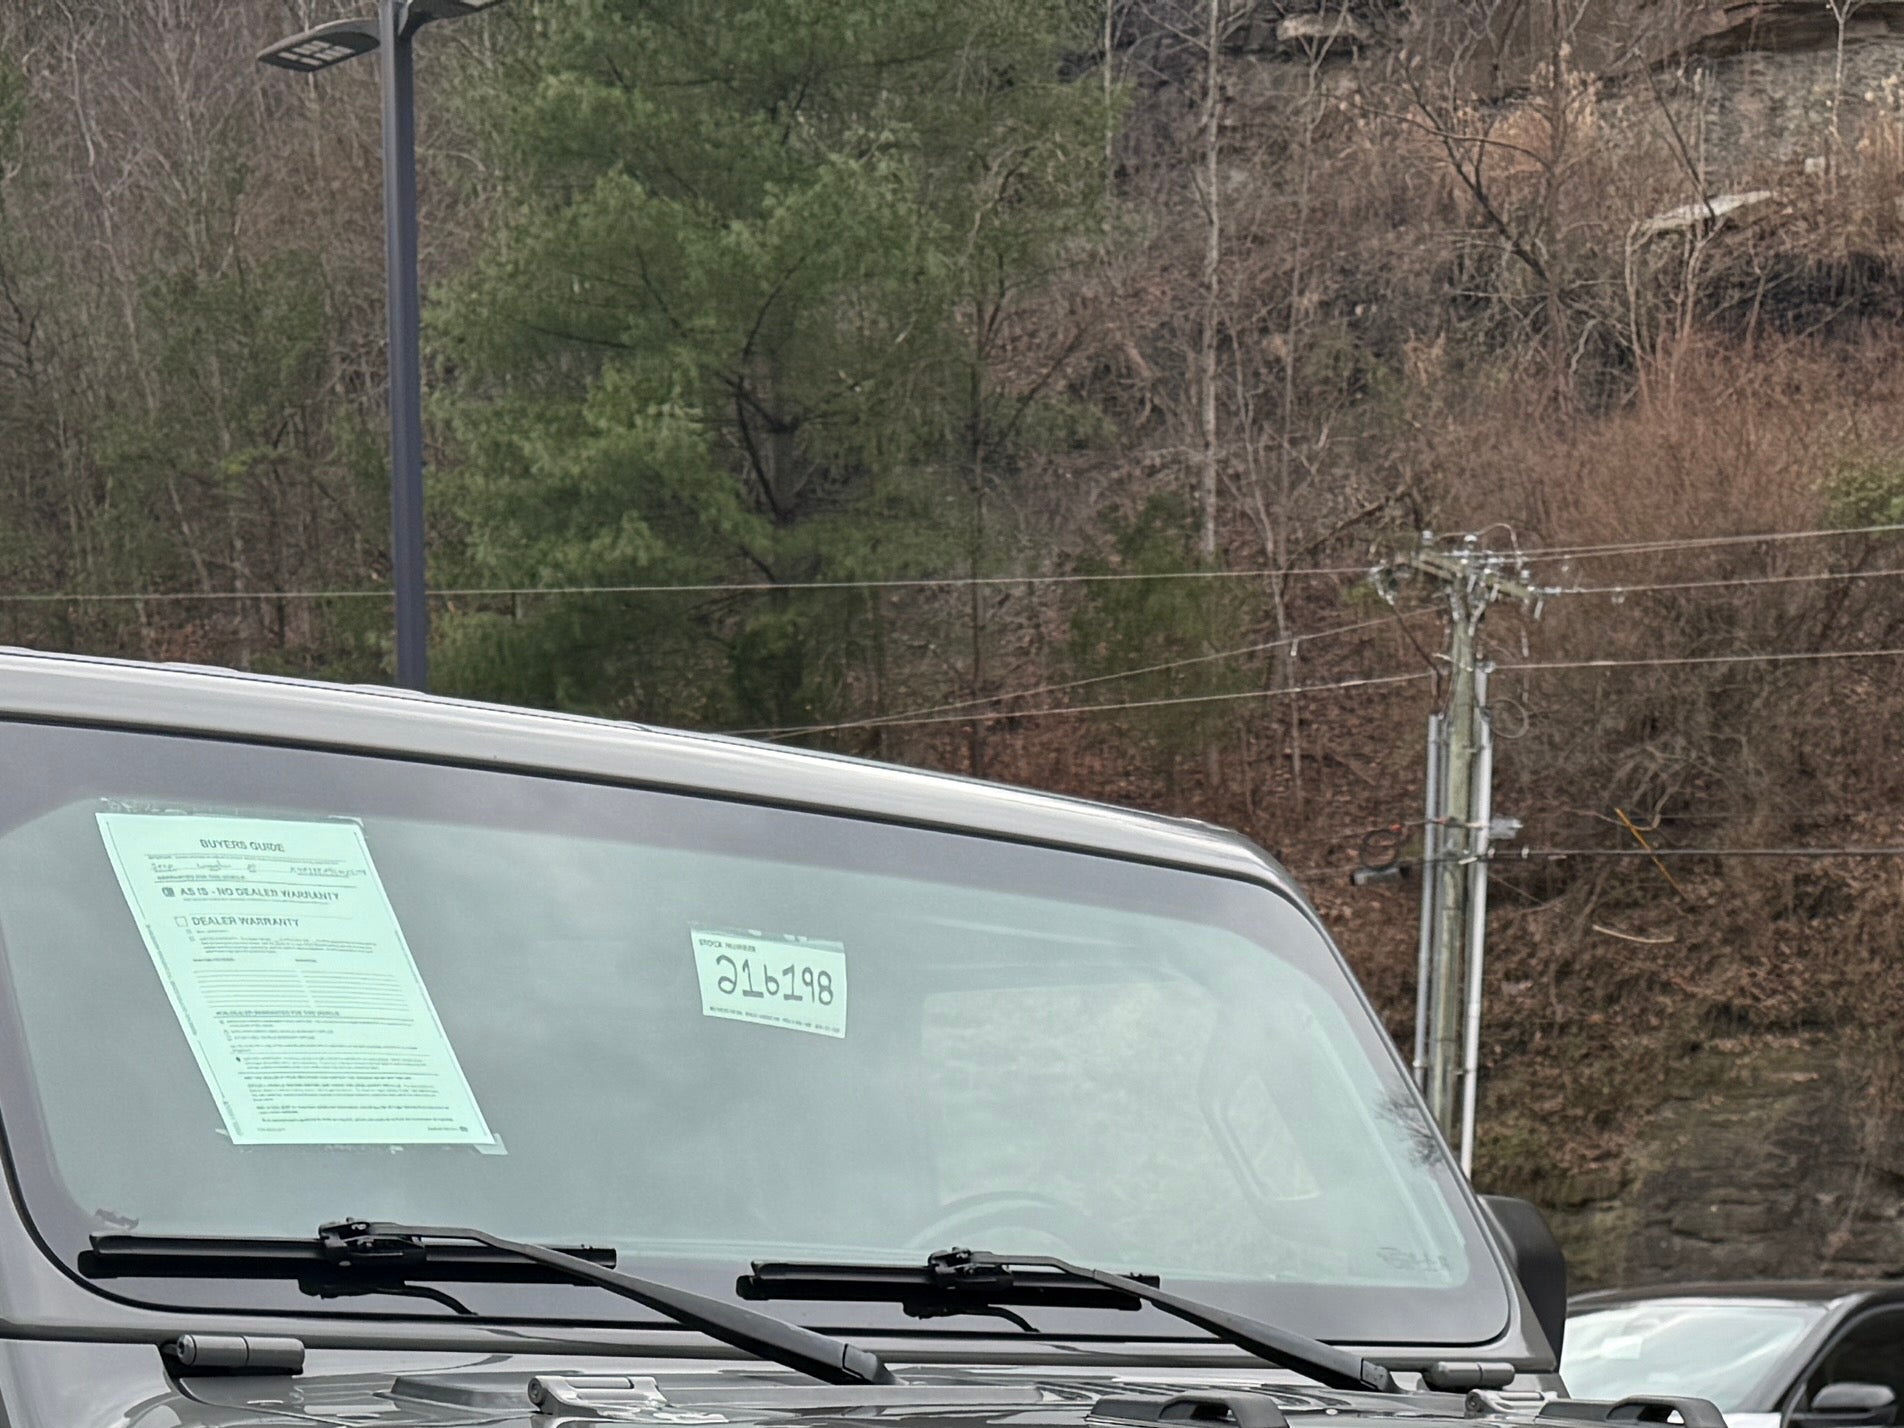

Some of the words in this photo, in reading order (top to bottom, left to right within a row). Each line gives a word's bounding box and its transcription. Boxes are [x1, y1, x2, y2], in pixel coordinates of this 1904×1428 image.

[199, 838, 247, 850] BUYERS
[250, 841, 285, 853] GUIDE
[180, 887, 195, 897] AS
[217, 887, 233, 897] NO
[236, 888, 278, 898] DEALER
[281, 889, 340, 901] WARRANTY
[192, 916, 237, 927] DEALER
[239, 917, 300, 928] WARRANTY
[715, 954, 834, 1006] 216198
